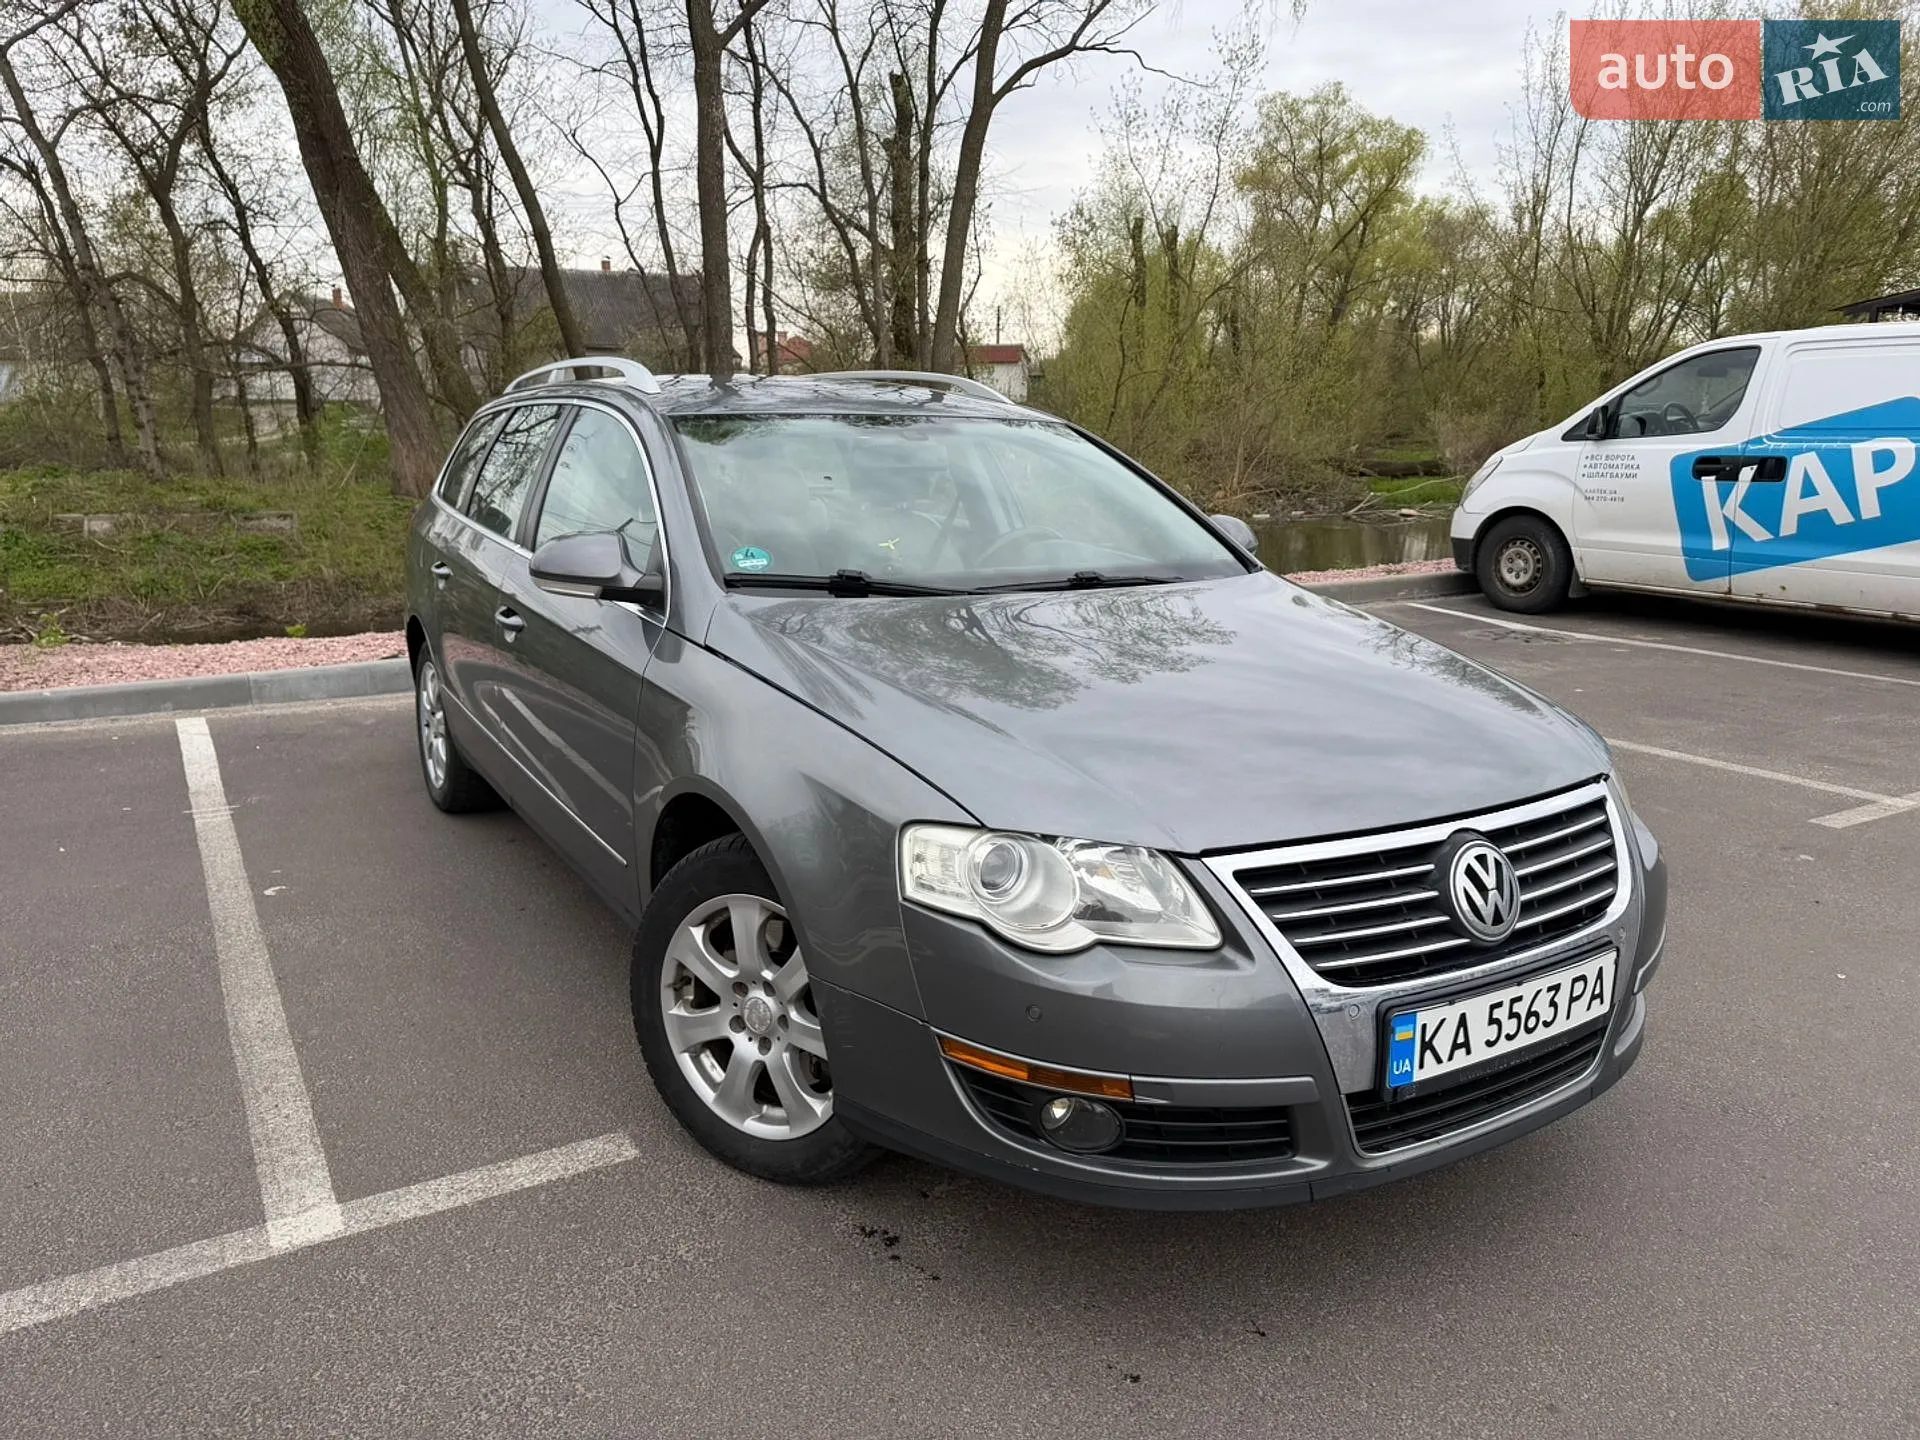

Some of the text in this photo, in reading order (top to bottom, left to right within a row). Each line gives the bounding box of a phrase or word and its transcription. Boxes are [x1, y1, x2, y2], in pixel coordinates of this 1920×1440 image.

[1604, 454, 1636, 462] ВОРОТА
[1455, 847, 1516, 932] VW
[1418, 1012, 1472, 1070] KA
[1484, 983, 1562, 1048] 5563
[1566, 965, 1605, 1020] PA
[1393, 1057, 1412, 1075] UA
